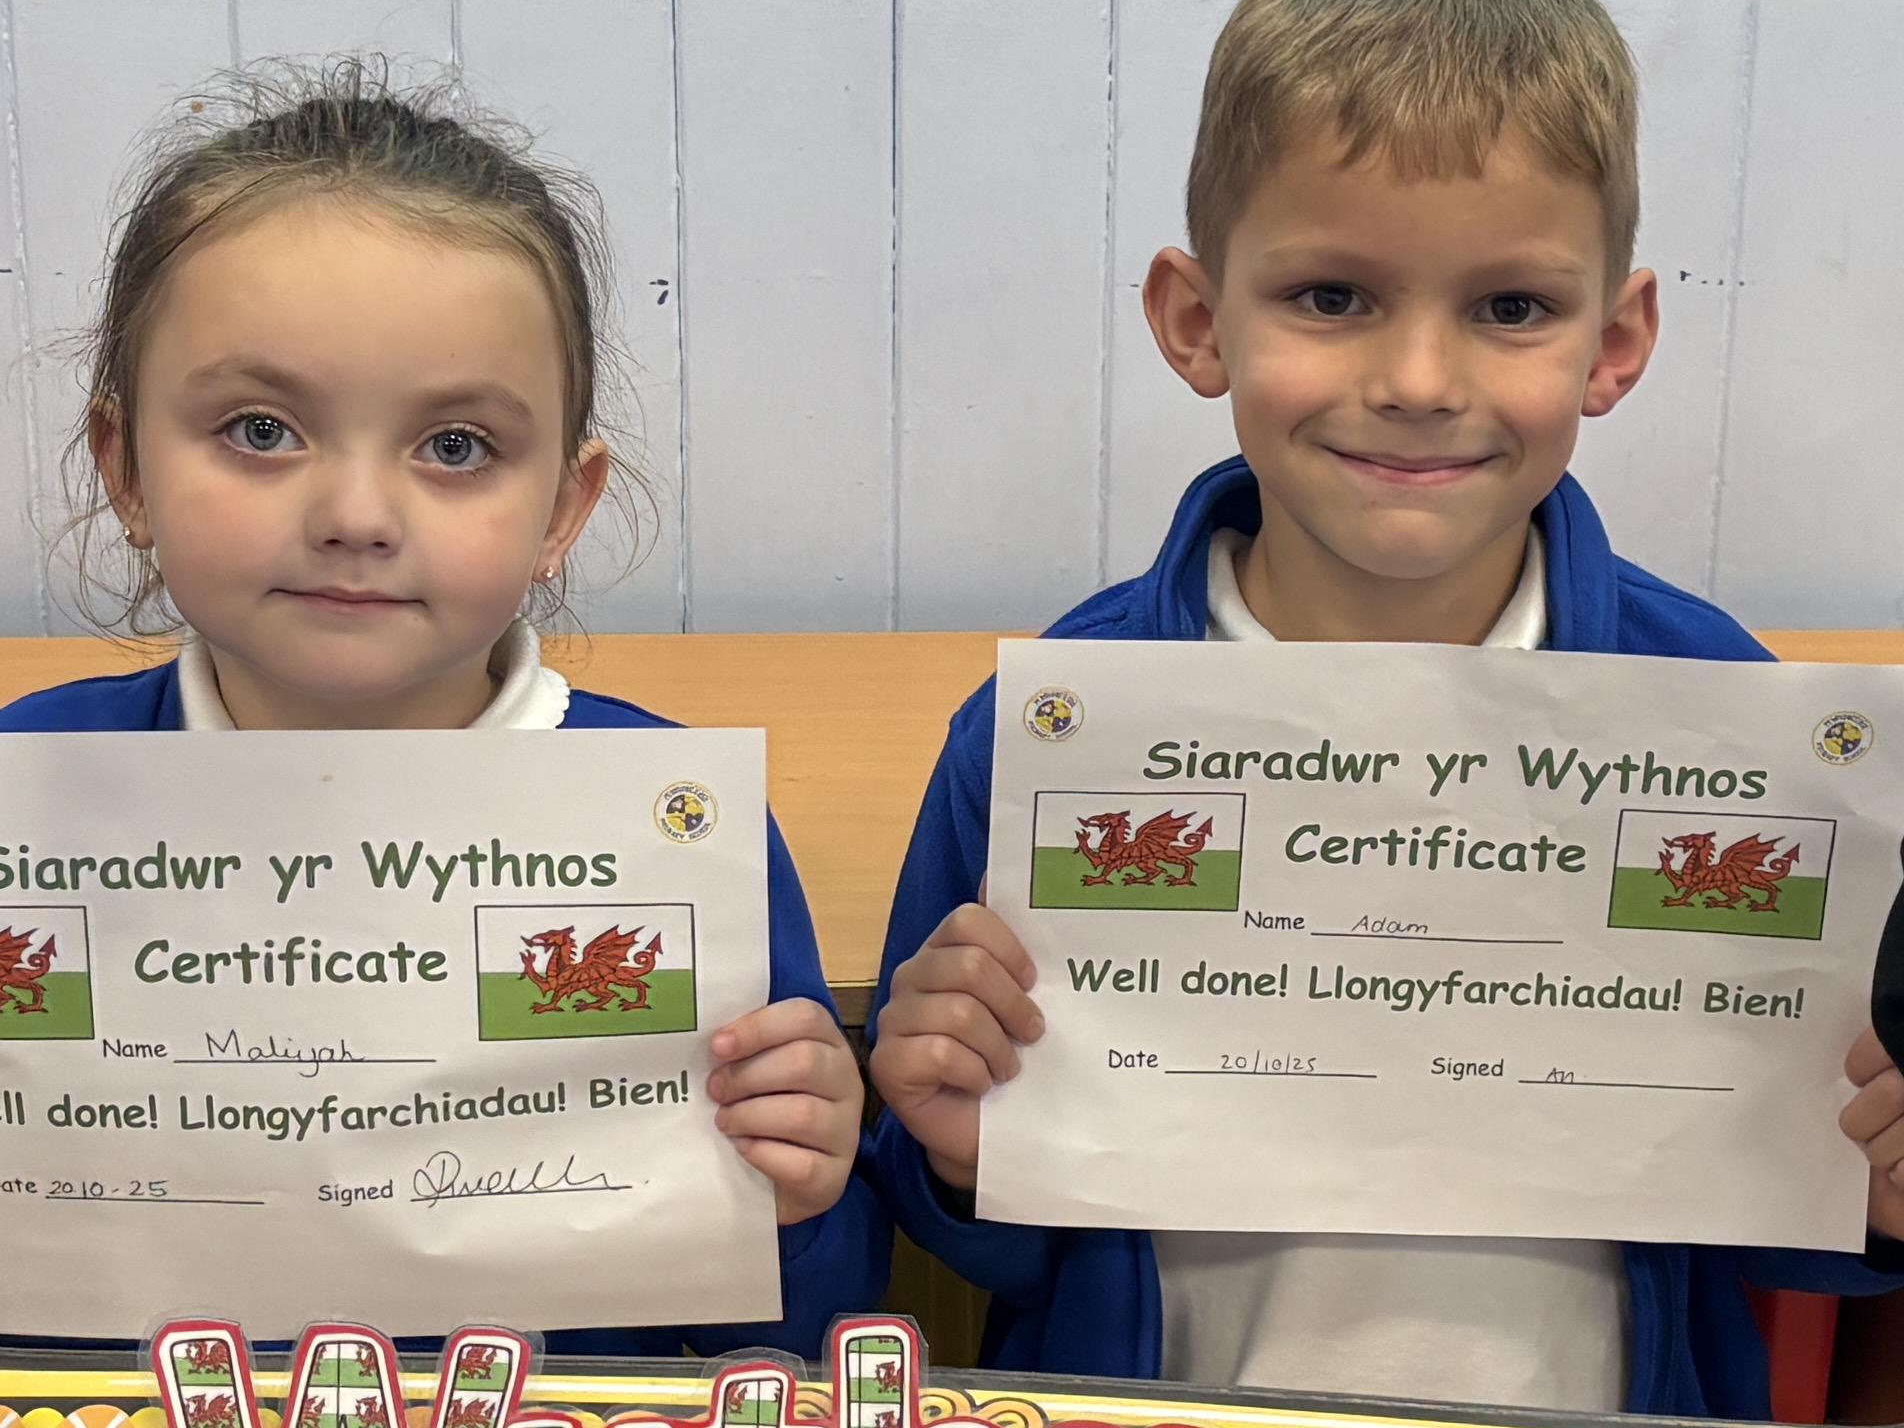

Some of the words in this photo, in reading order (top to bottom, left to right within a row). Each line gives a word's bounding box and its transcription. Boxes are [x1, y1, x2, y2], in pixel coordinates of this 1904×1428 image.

[1143, 739, 1400, 784] Siaradwr
[1426, 753, 1488, 797] yr
[1517, 744, 1768, 798] Wythnos
[268, 854, 333, 904] yr
[360, 838, 618, 903] Wythnos
[1285, 824, 1586, 873] Certificate
[1244, 910, 1305, 930] Name
[1351, 914, 1428, 934] Adam
[134, 936, 448, 987] Certificate
[1066, 958, 1160, 993] Well
[1181, 960, 1288, 998] done!
[1308, 965, 1682, 1013] Llongyfarchiadau!
[1704, 982, 1804, 1019] Bien!
[102, 1038, 167, 1058] Name
[1108, 1049, 1158, 1069] Date
[1431, 1057, 1504, 1081] Signed
[47, 1093, 158, 1129] done!
[179, 1080, 566, 1143] Llongyfarchiadau!
[589, 1070, 688, 1109] Bien!
[318, 1179, 394, 1207] Signed
